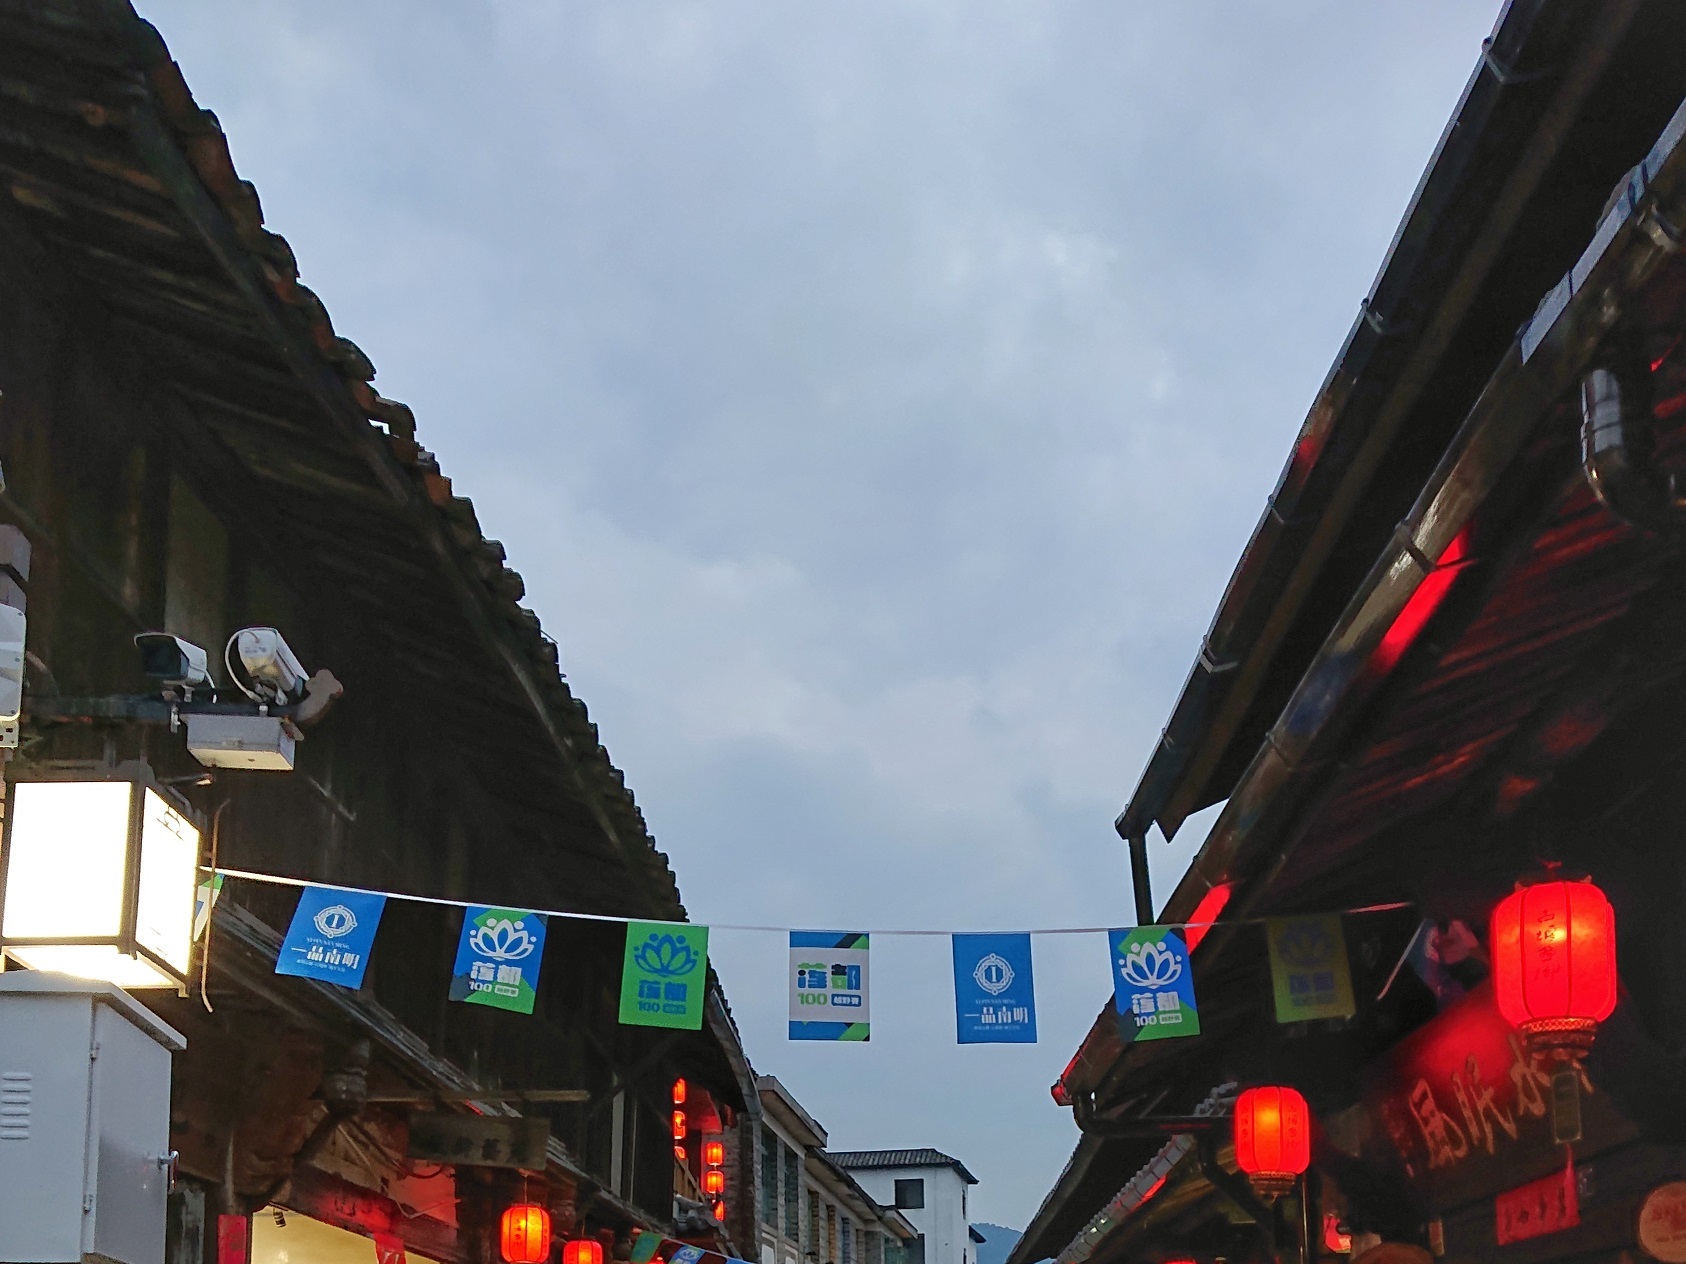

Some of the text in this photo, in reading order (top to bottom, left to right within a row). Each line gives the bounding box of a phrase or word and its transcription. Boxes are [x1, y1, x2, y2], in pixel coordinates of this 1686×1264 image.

[290, 945, 361, 970] 一品南明
[797, 962, 861, 991] 莲都
[468, 981, 493, 993] 100
[797, 993, 828, 1006] 100
[964, 1005, 1029, 1024] 一品南明
[1133, 1014, 1158, 1027] 100
